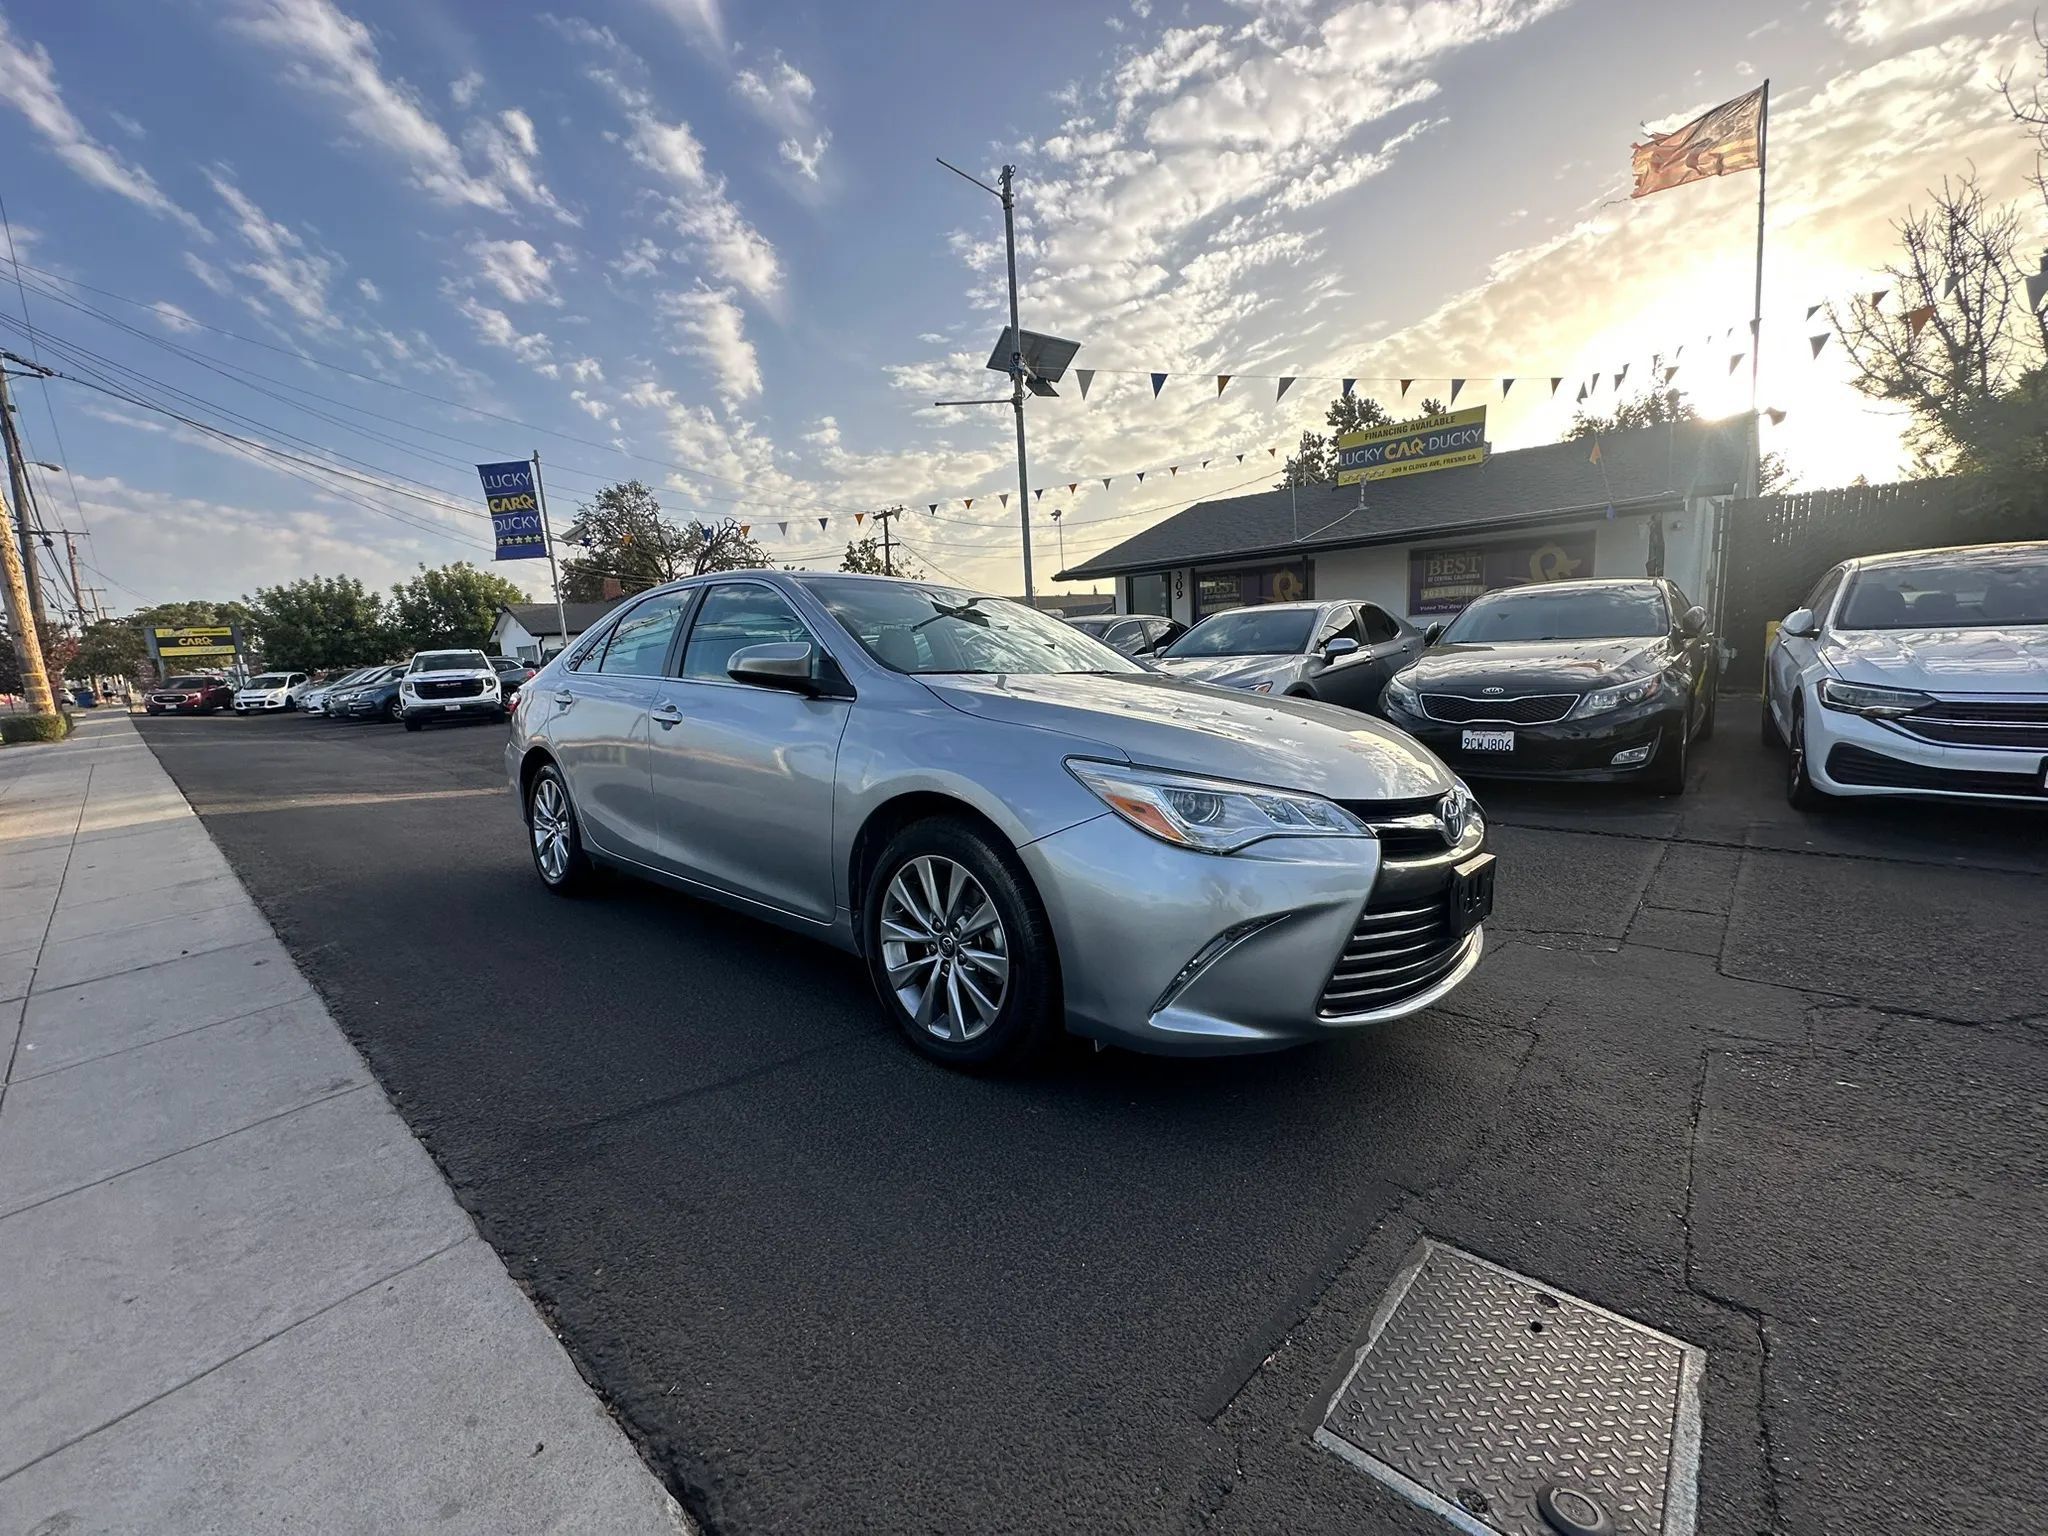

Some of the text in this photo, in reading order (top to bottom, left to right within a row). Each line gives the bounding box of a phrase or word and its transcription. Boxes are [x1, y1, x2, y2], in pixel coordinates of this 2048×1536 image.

[1364, 415, 1456, 441] FINANCING AVAILABLE
[1339, 447, 1383, 467] LUCKY
[1429, 428, 1483, 450] DUCKY
[1408, 462, 1428, 471] CLOVIS
[1443, 456, 1467, 465] FRESNO
[482, 472, 531, 489] LUCKY
[493, 515, 539, 533] DUCKY
[1428, 556, 1482, 577] BEST
[1463, 737, 1512, 751] 9CWJ806
